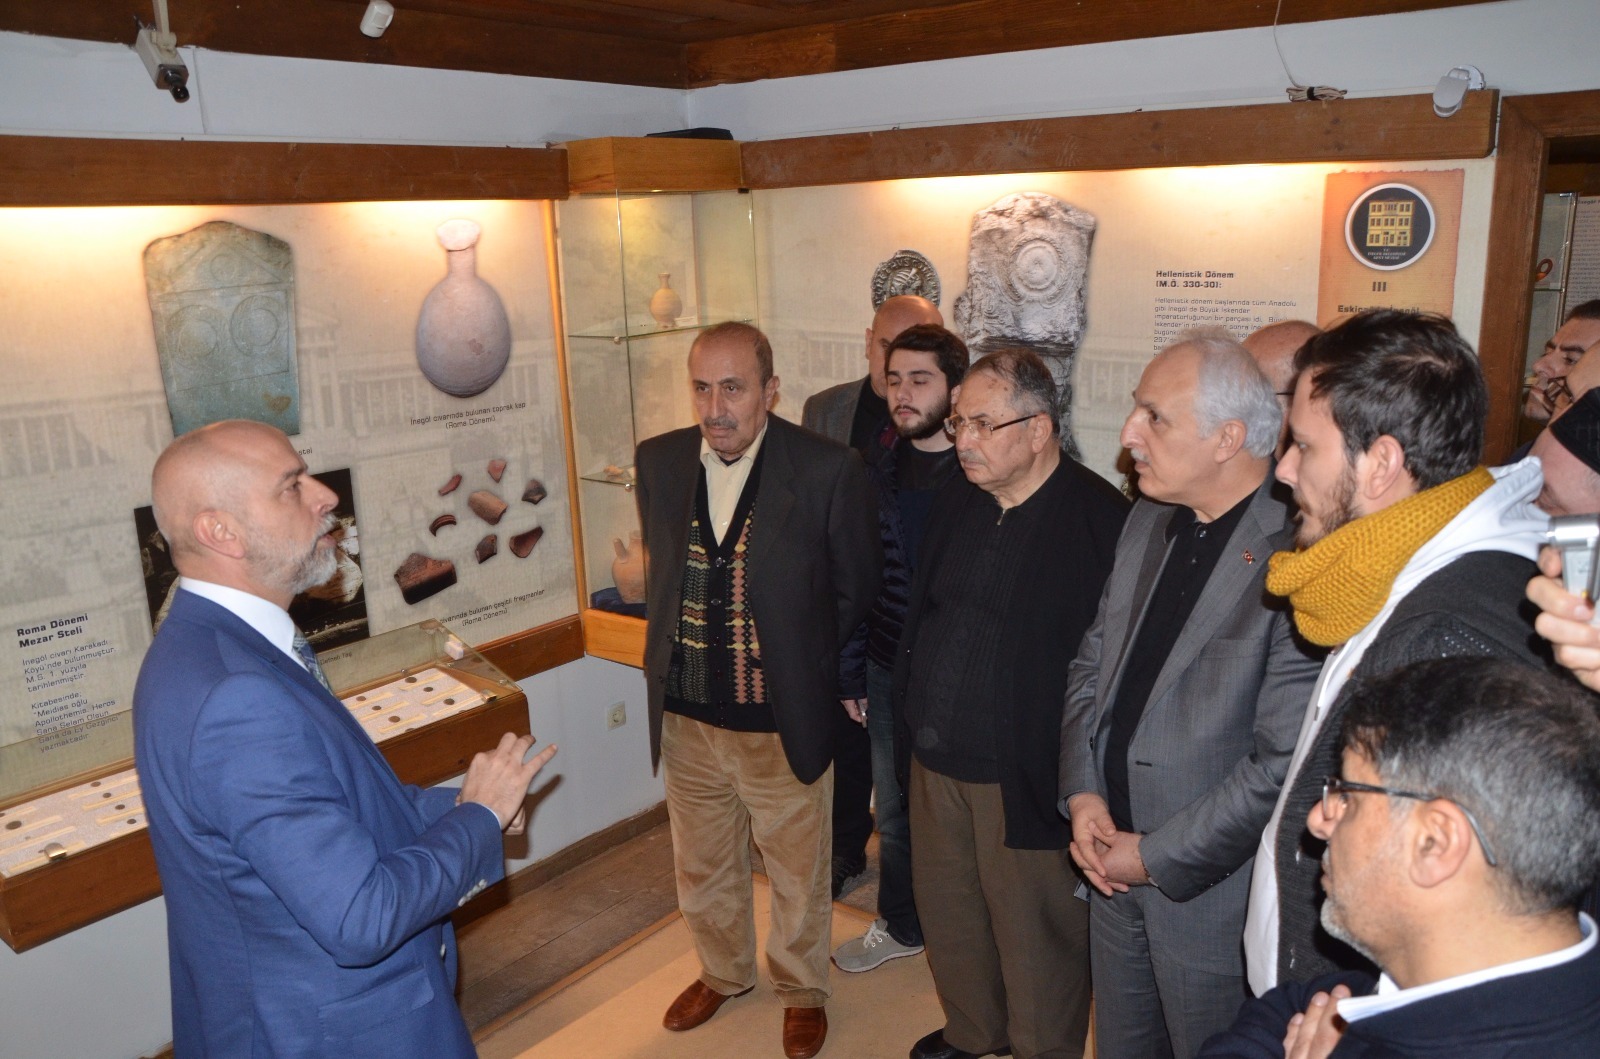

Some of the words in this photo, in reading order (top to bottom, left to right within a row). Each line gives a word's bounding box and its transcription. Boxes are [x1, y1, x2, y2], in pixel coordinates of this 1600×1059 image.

[1155, 270, 1202, 278] Hellenistik
[1204, 271, 1234, 279] Dönem
[1182, 280, 1222, 289] 330-30):
[1372, 281, 1387, 292] III
[465, 408, 491, 418] bulunan
[492, 404, 514, 415] toprak
[469, 604, 493, 617] bulunan
[16, 624, 47, 637] Roma
[50, 613, 89, 630] Dönemi
[18, 633, 54, 648] Mezar
[57, 625, 83, 639] Steli
[50, 648, 72, 660] civarı
[74, 639, 108, 653] Karakadı
[64, 647, 117, 665] bulunmuştur.
[26, 673, 46, 684] M.S.
[71, 698, 88, 709] oğlu
[92, 699, 116, 711] Heros
[36, 725, 58, 736] Sana
[60, 718, 85, 729] Selam
[61, 729, 72, 737] da
